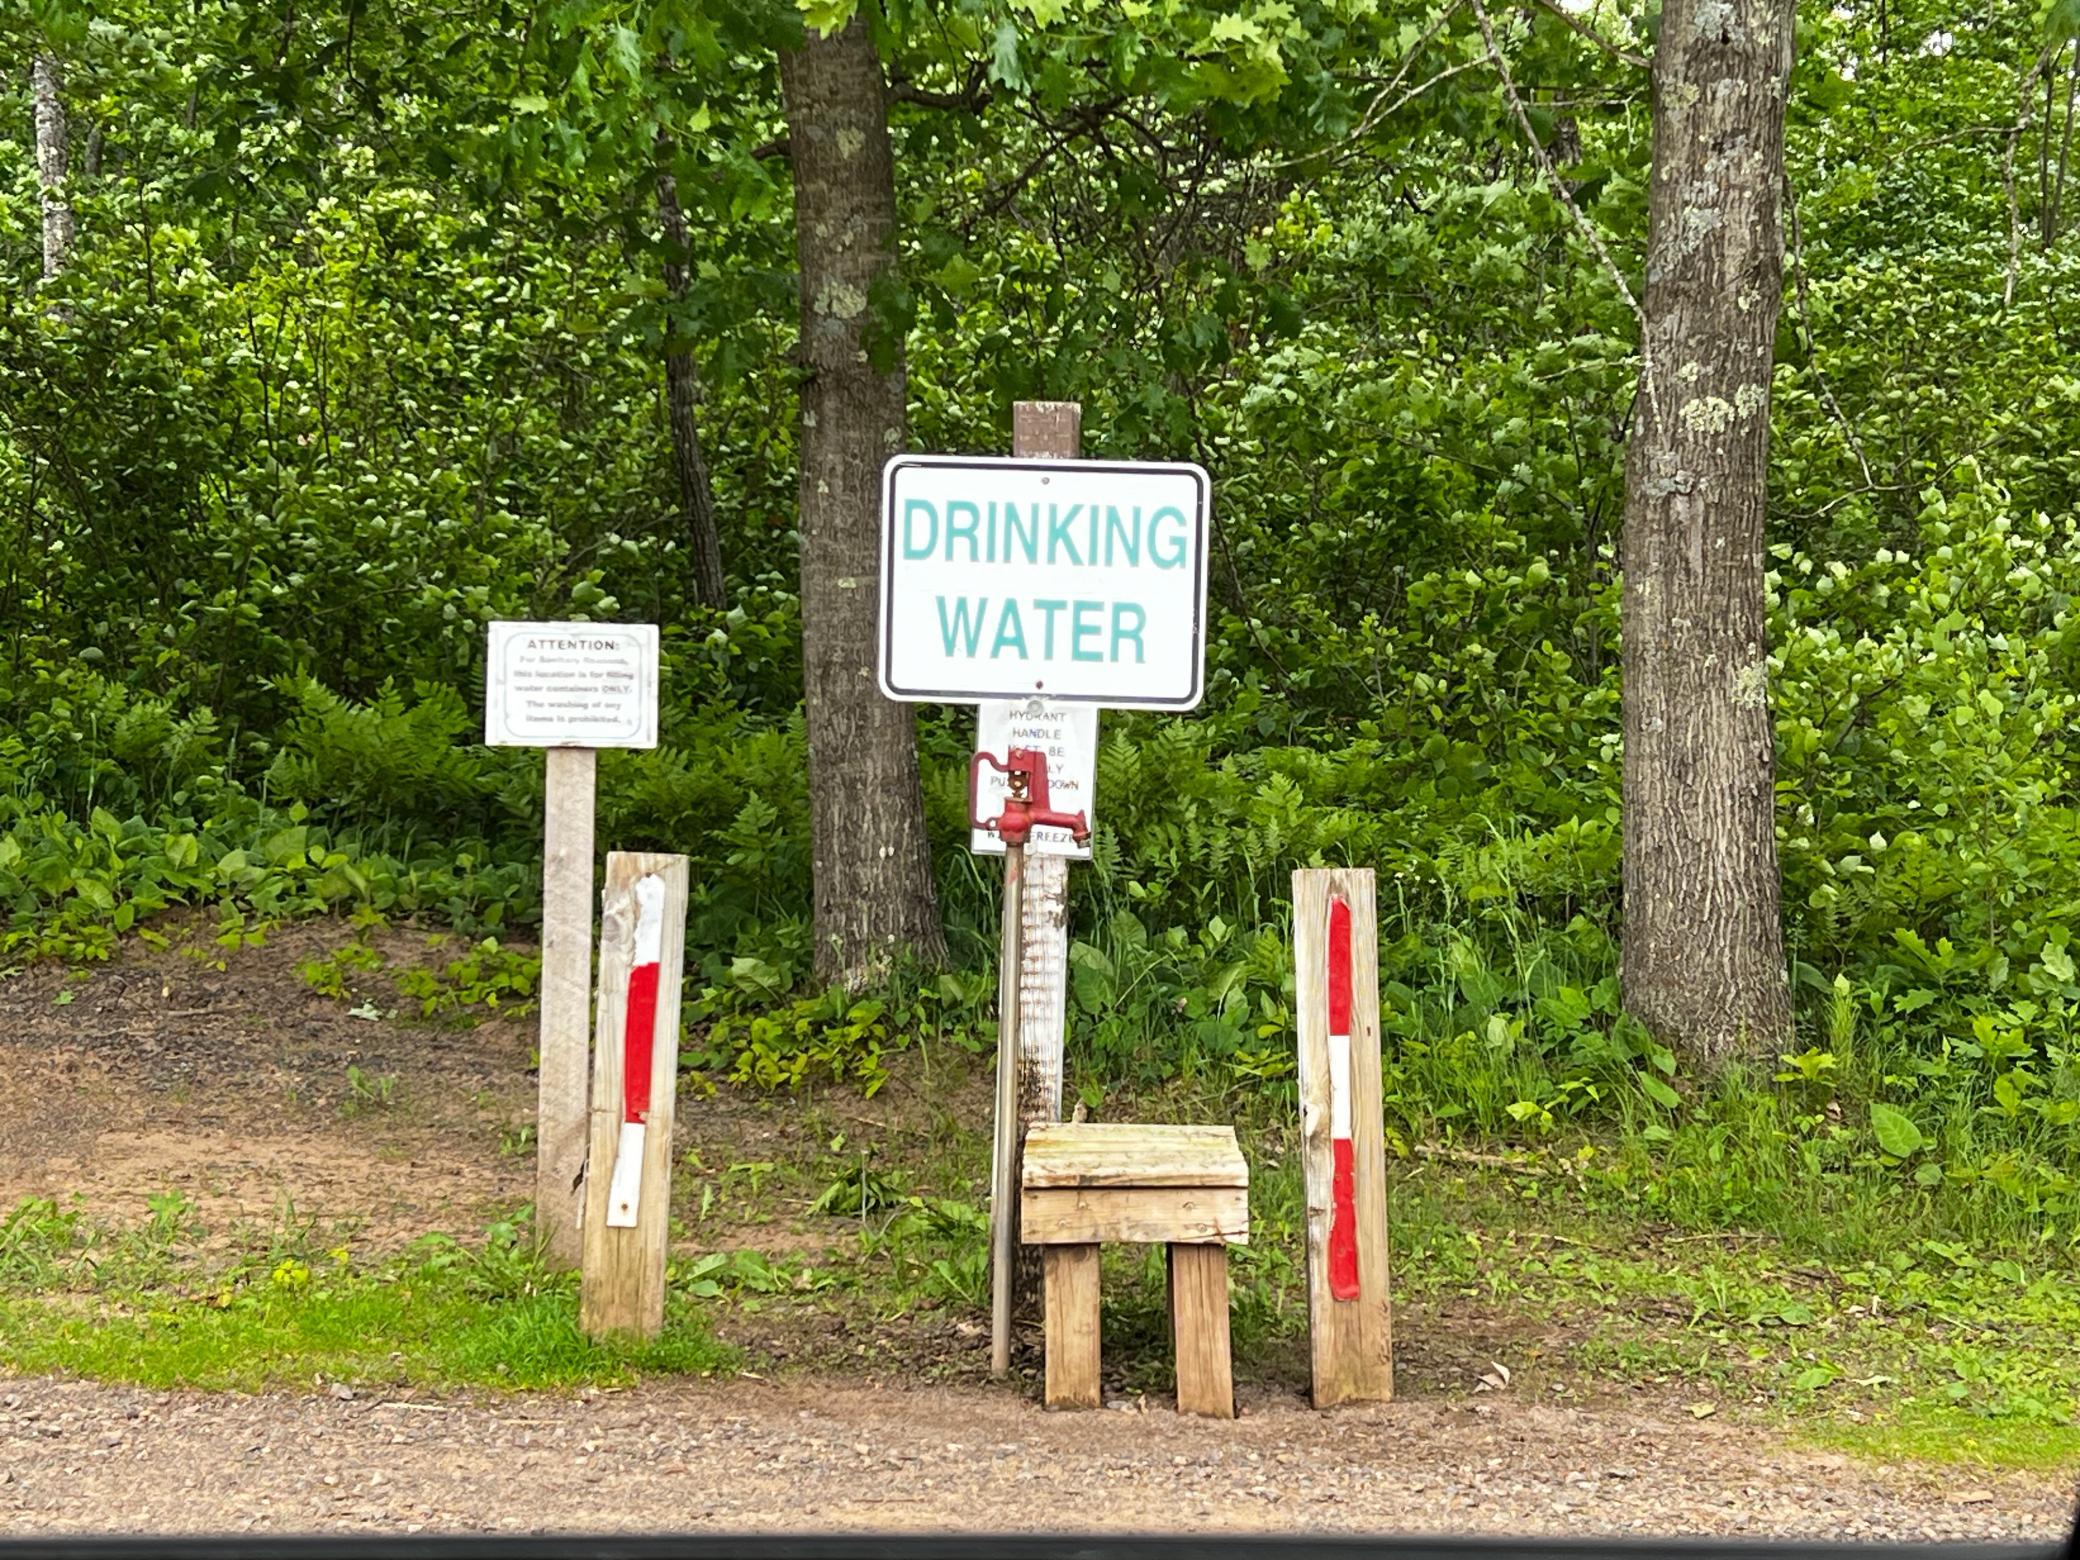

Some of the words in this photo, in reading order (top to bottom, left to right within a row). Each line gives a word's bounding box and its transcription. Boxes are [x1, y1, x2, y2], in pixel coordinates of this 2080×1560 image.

[903, 499, 1187, 569] DRINKING
[935, 596, 1146, 664] WATER
[528, 640, 620, 650] ATTENTION:
[536, 670, 576, 678] location
[590, 671, 604, 679] for
[546, 684, 599, 693] containers
[526, 700, 545, 708] The
[548, 701, 589, 710] washing
[592, 701, 602, 709] of
[604, 703, 622, 711] any
[526, 714, 554, 722] items
[1012, 728, 1062, 740] HANDLE
[1048, 746, 1064, 757] BE
